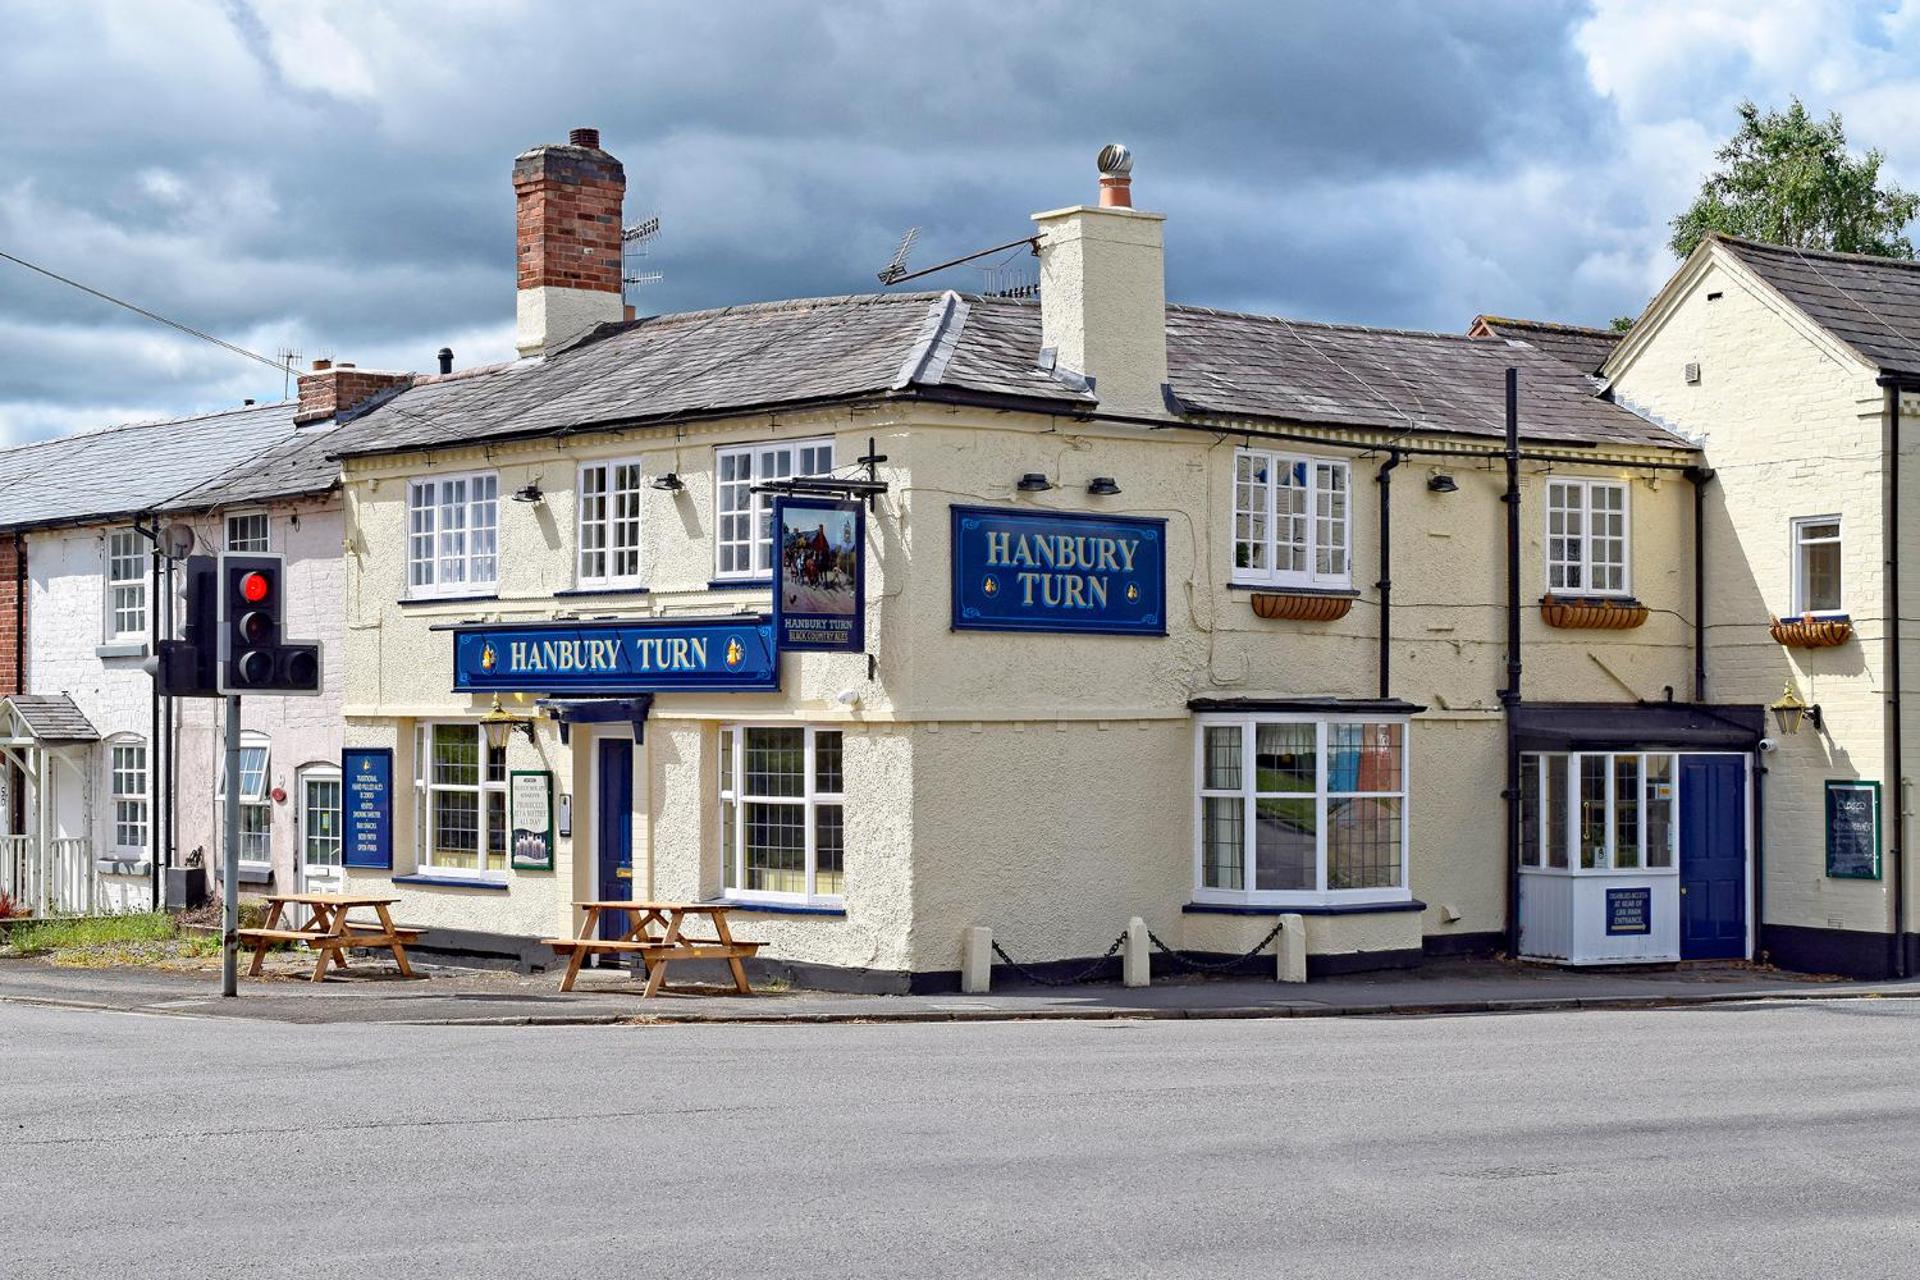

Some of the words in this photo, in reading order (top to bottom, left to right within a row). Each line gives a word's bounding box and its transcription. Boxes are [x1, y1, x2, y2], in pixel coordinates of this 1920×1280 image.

[985, 531, 1140, 572] HANBURY
[1017, 572, 1109, 609] TURN
[784, 618, 827, 630] HANBURY
[828, 619, 853, 631] TURN
[509, 638, 622, 671] HANBURY
[636, 637, 708, 669] TURN
